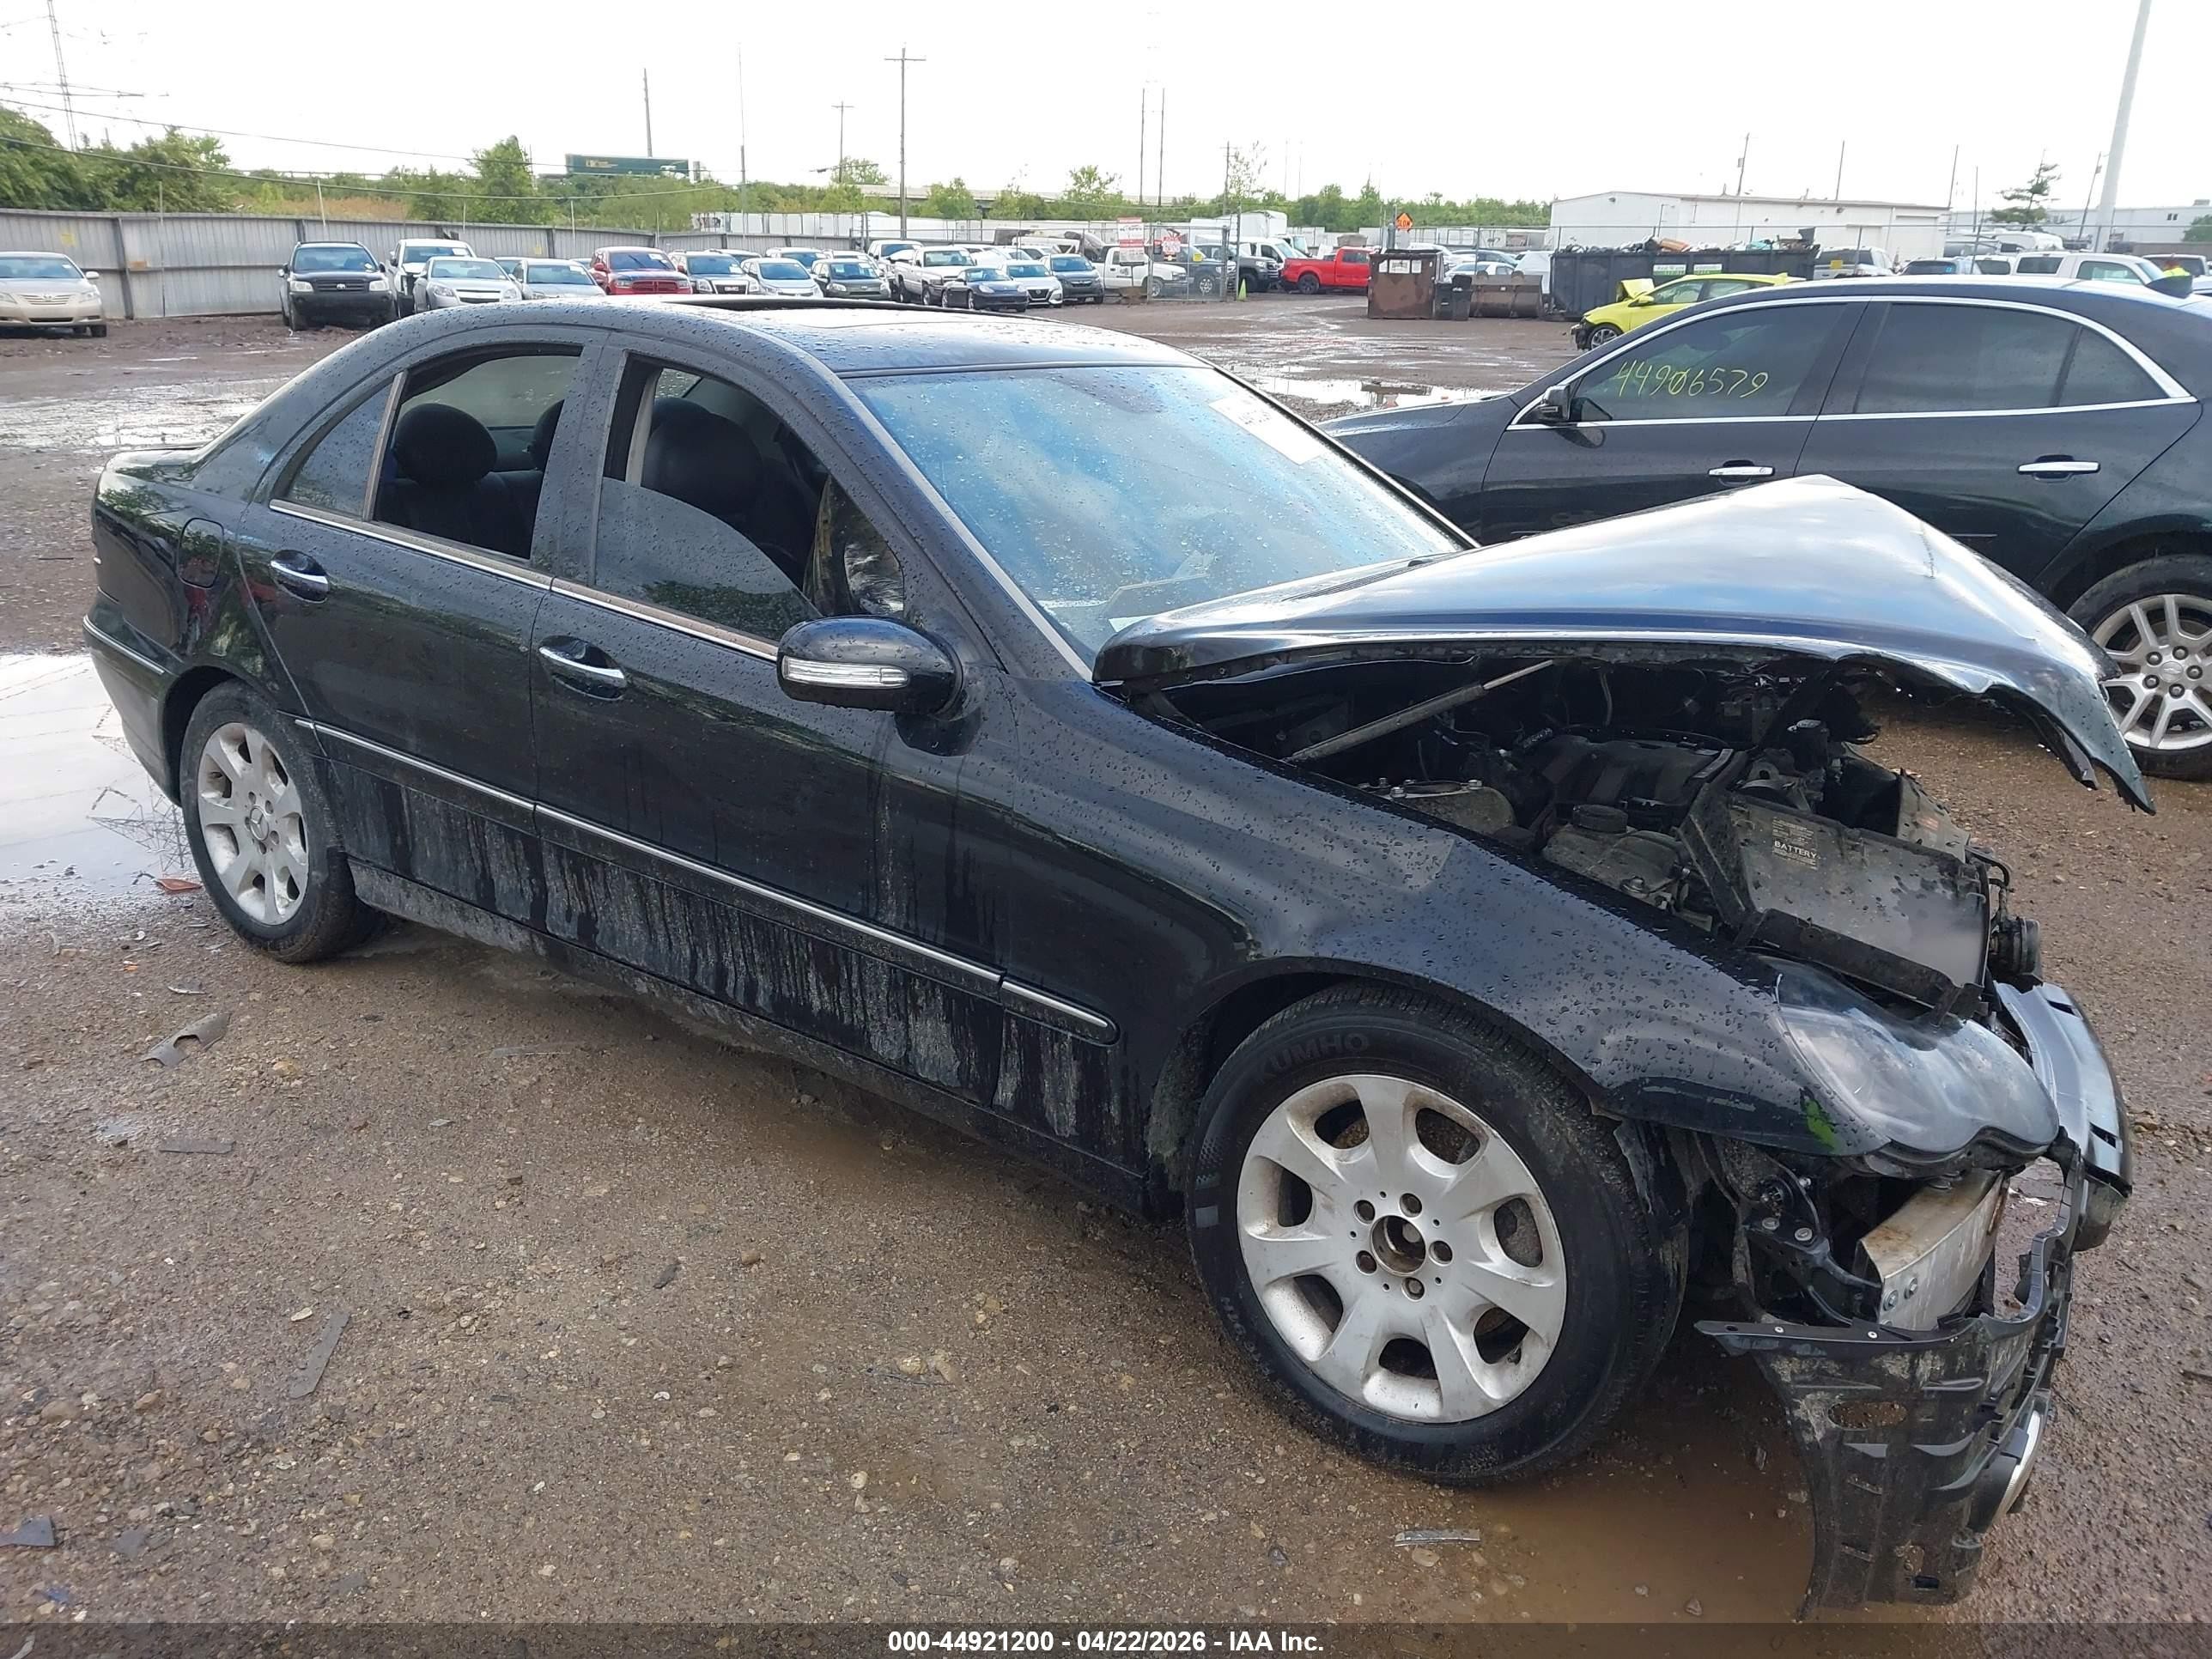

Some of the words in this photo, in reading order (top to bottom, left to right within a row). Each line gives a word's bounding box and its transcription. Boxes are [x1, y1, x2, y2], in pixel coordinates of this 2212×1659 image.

[1613, 359, 1770, 398] 44906579
[1774, 841, 1818, 860] BATTERY
[1255, 1032, 1370, 1084] KUMHO
